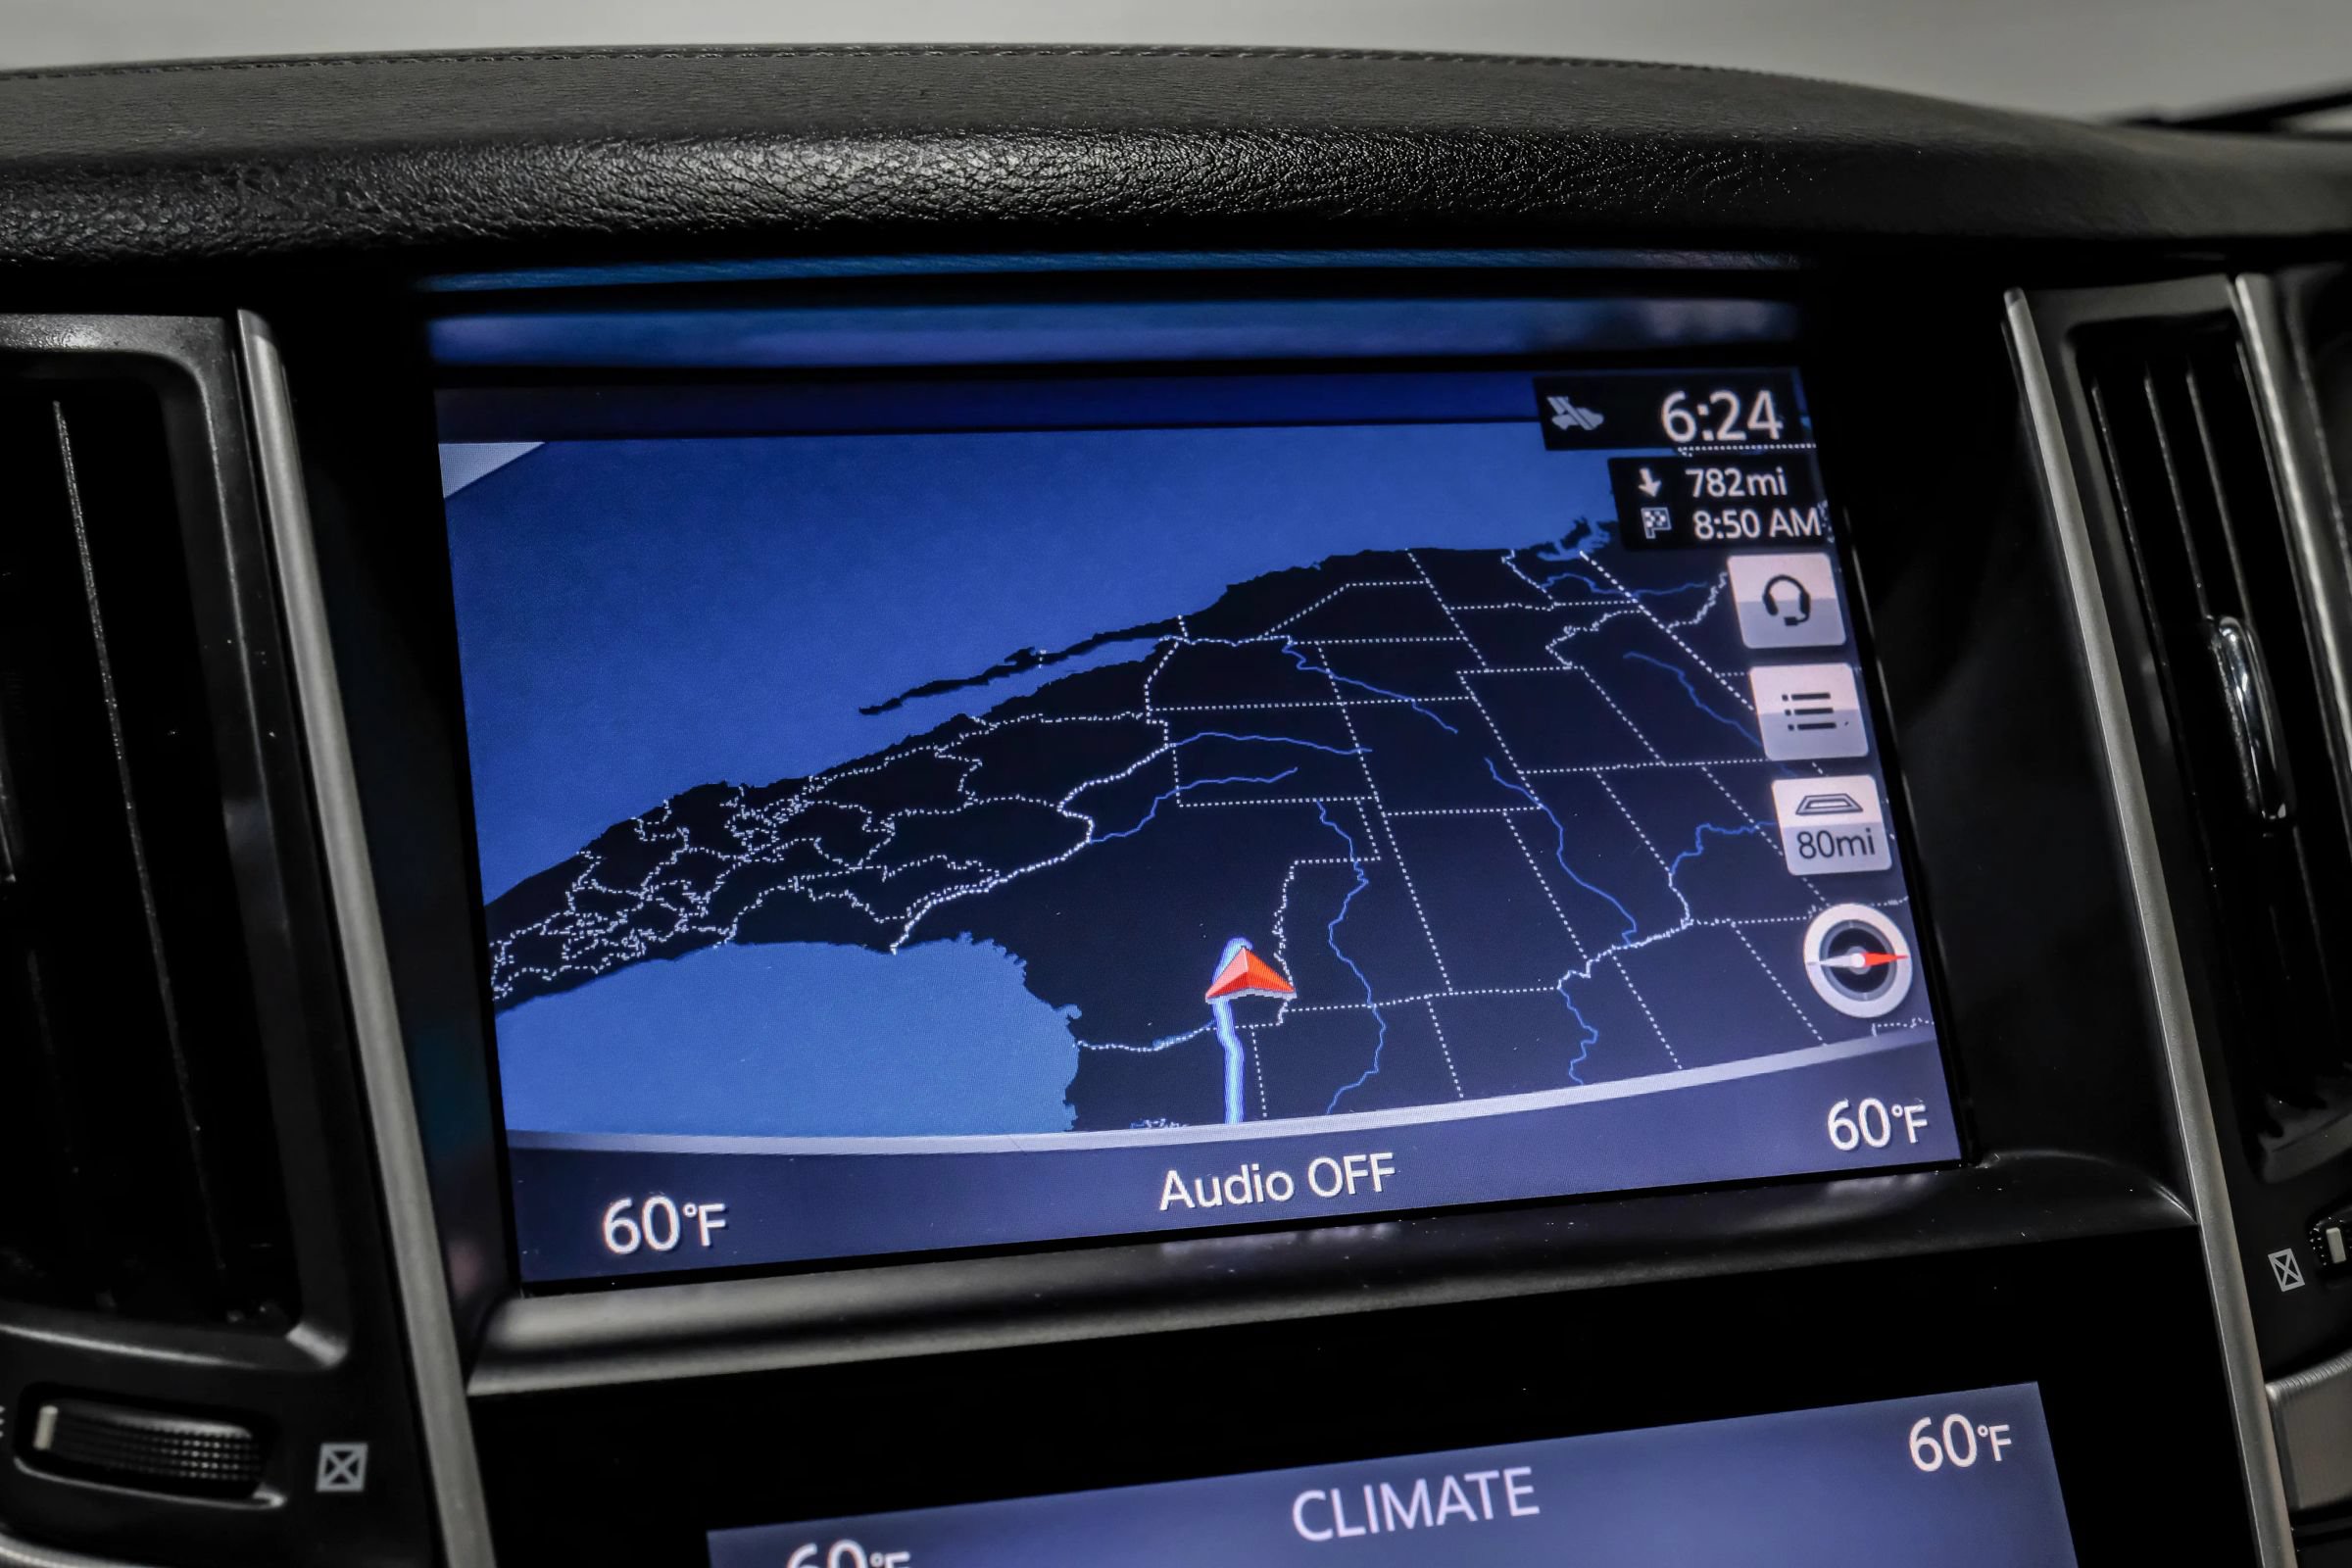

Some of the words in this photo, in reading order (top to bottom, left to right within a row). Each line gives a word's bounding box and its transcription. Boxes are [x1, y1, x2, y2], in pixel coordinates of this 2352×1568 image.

[1661, 390, 1784, 443] 6:24
[1685, 466, 1788, 498] 782mi
[1692, 509, 1761, 540] 8:50
[1769, 507, 1822, 538] AM
[1796, 827, 1876, 860] 80mi
[1159, 1162, 1296, 1212] Audio
[1307, 1152, 1396, 1199] OFF
[1292, 1466, 1541, 1543] CLIMATE
